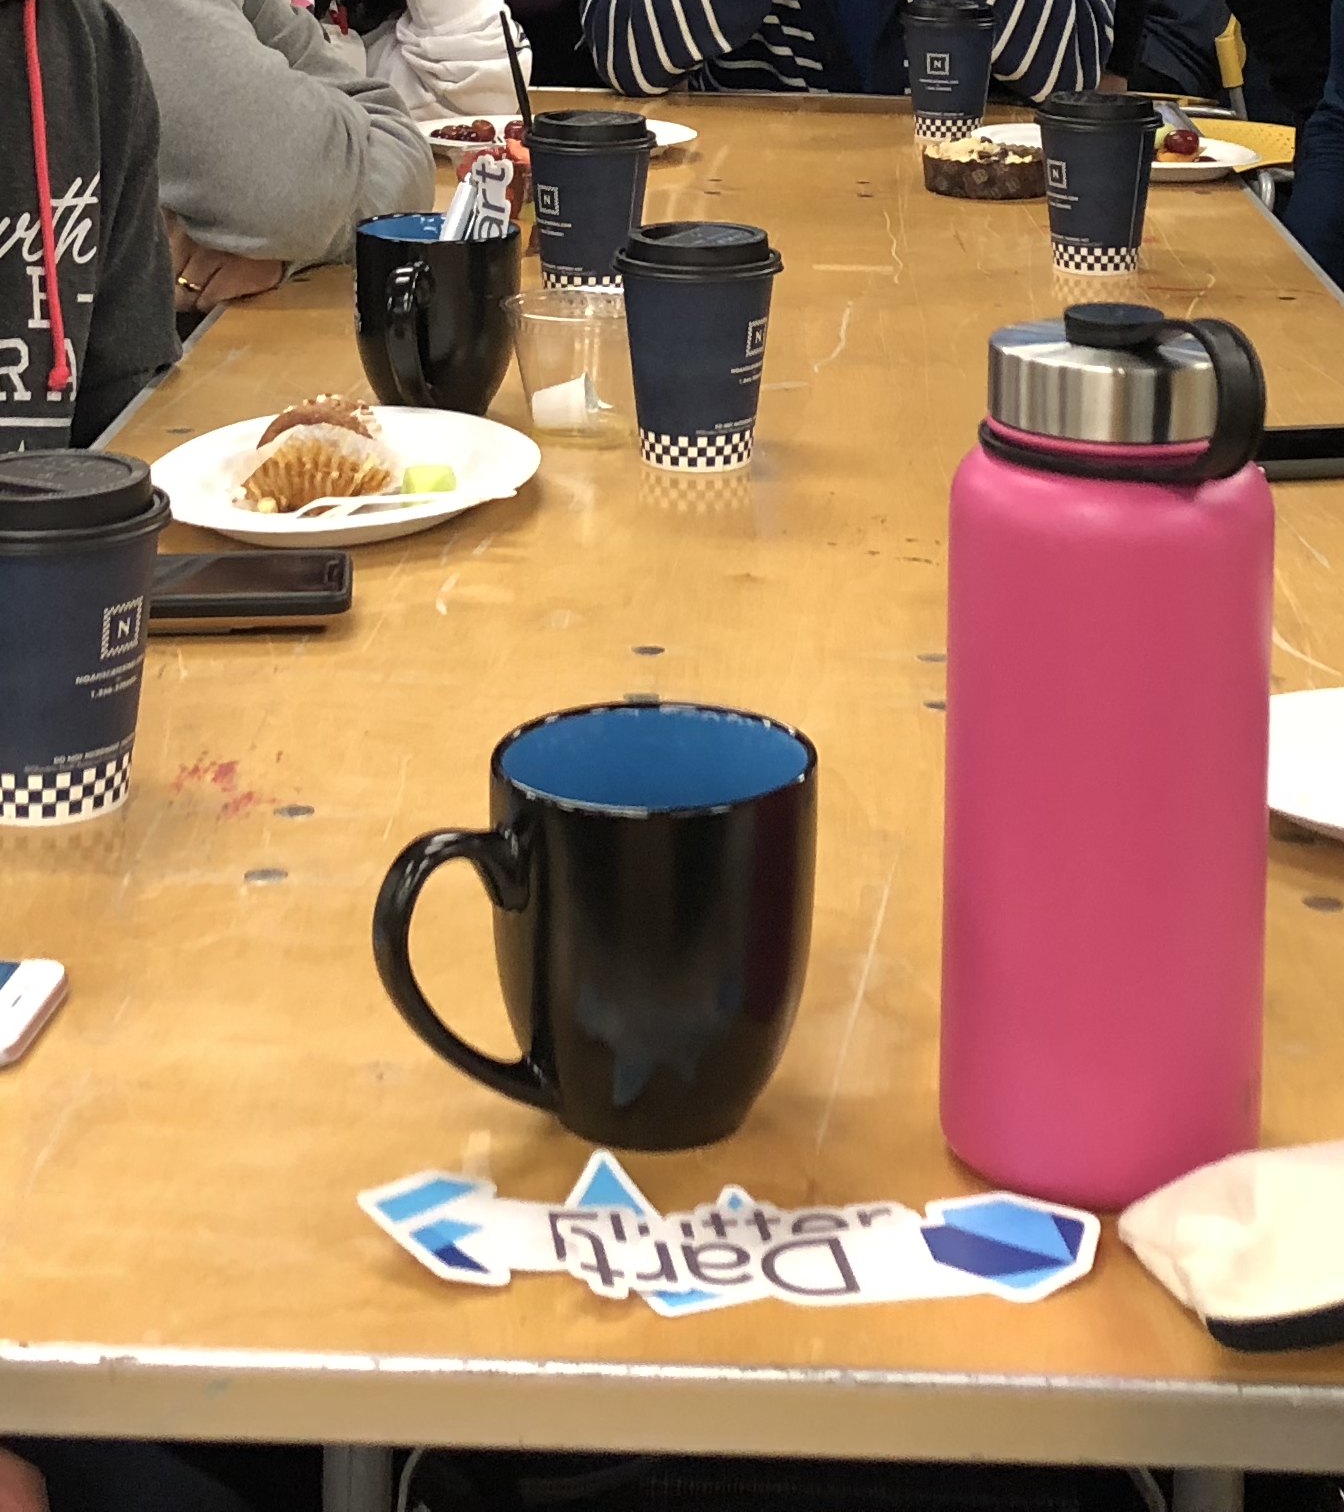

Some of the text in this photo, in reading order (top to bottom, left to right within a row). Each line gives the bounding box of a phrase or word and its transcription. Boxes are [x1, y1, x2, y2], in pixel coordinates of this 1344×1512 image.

[934, 60, 942, 68] N
[1052, 169, 1060, 179] N
[543, 194, 551, 205] N
[755, 330, 763, 344] N
[117, 617, 131, 639] N
[570, 1226, 861, 1296] Dart
